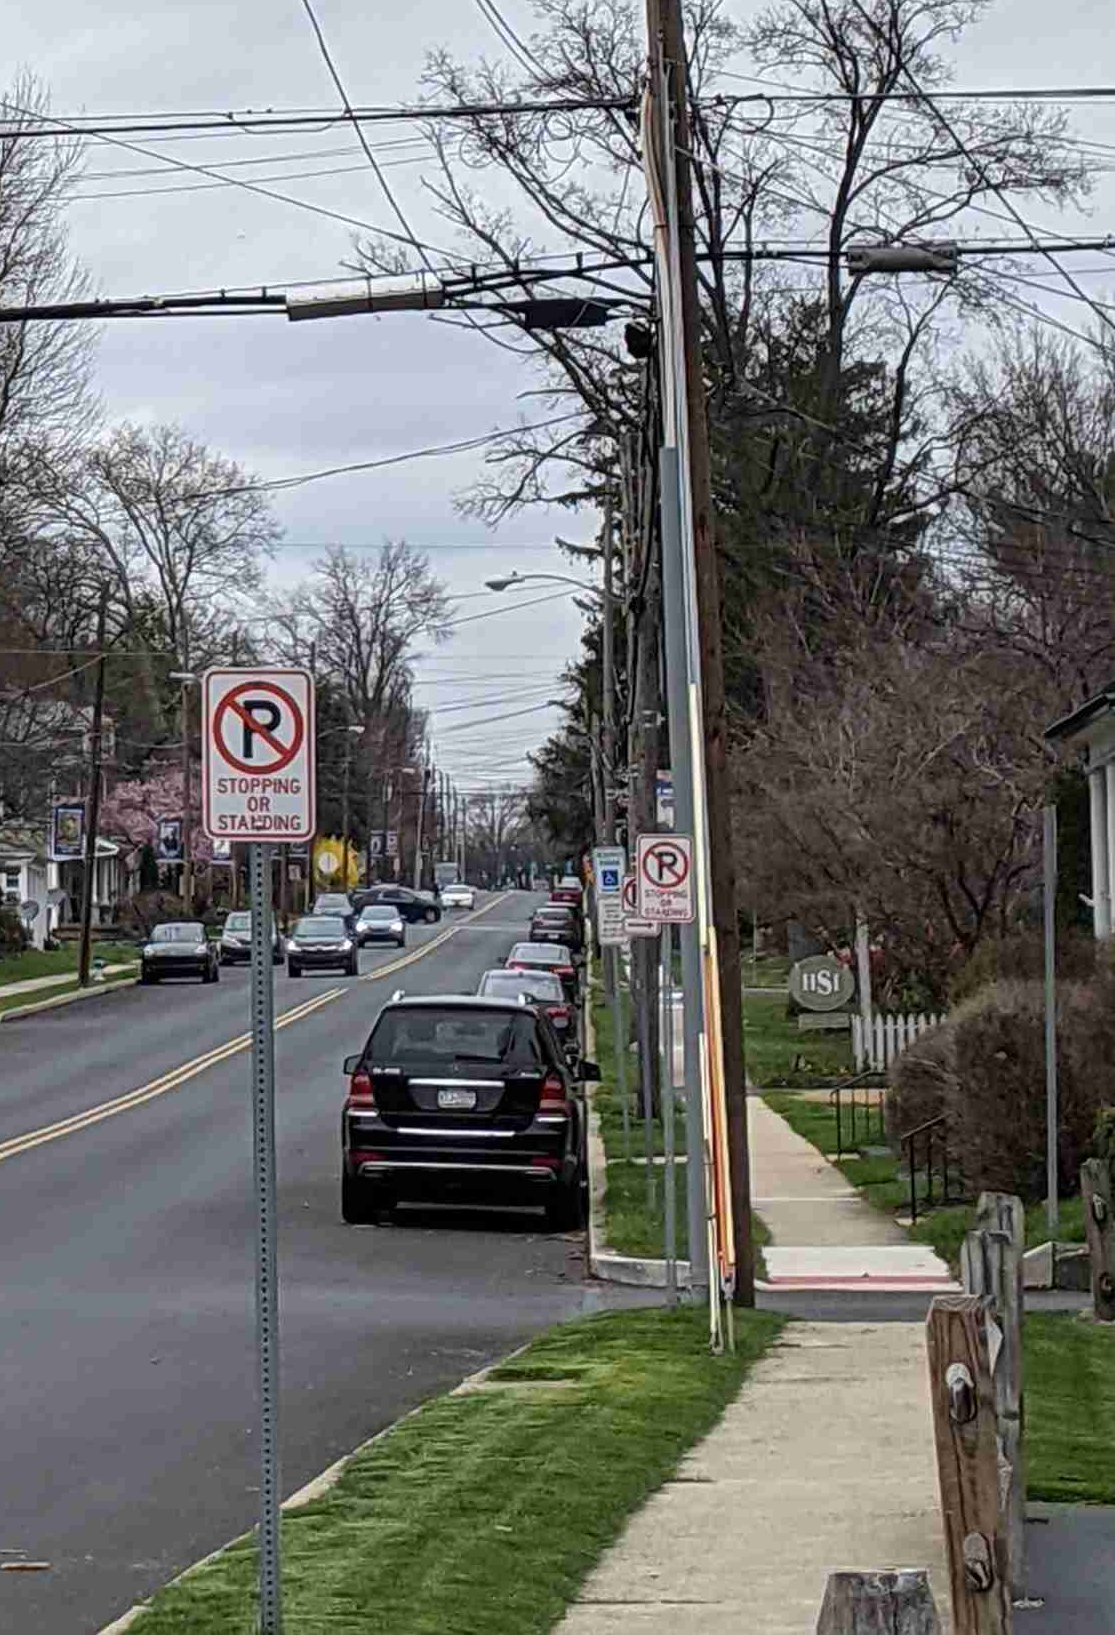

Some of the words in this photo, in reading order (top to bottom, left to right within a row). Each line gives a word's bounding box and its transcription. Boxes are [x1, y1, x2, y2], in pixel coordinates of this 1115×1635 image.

[217, 778, 302, 794] STOPPING
[247, 796, 271, 813] OR
[218, 814, 302, 831] STANDING
